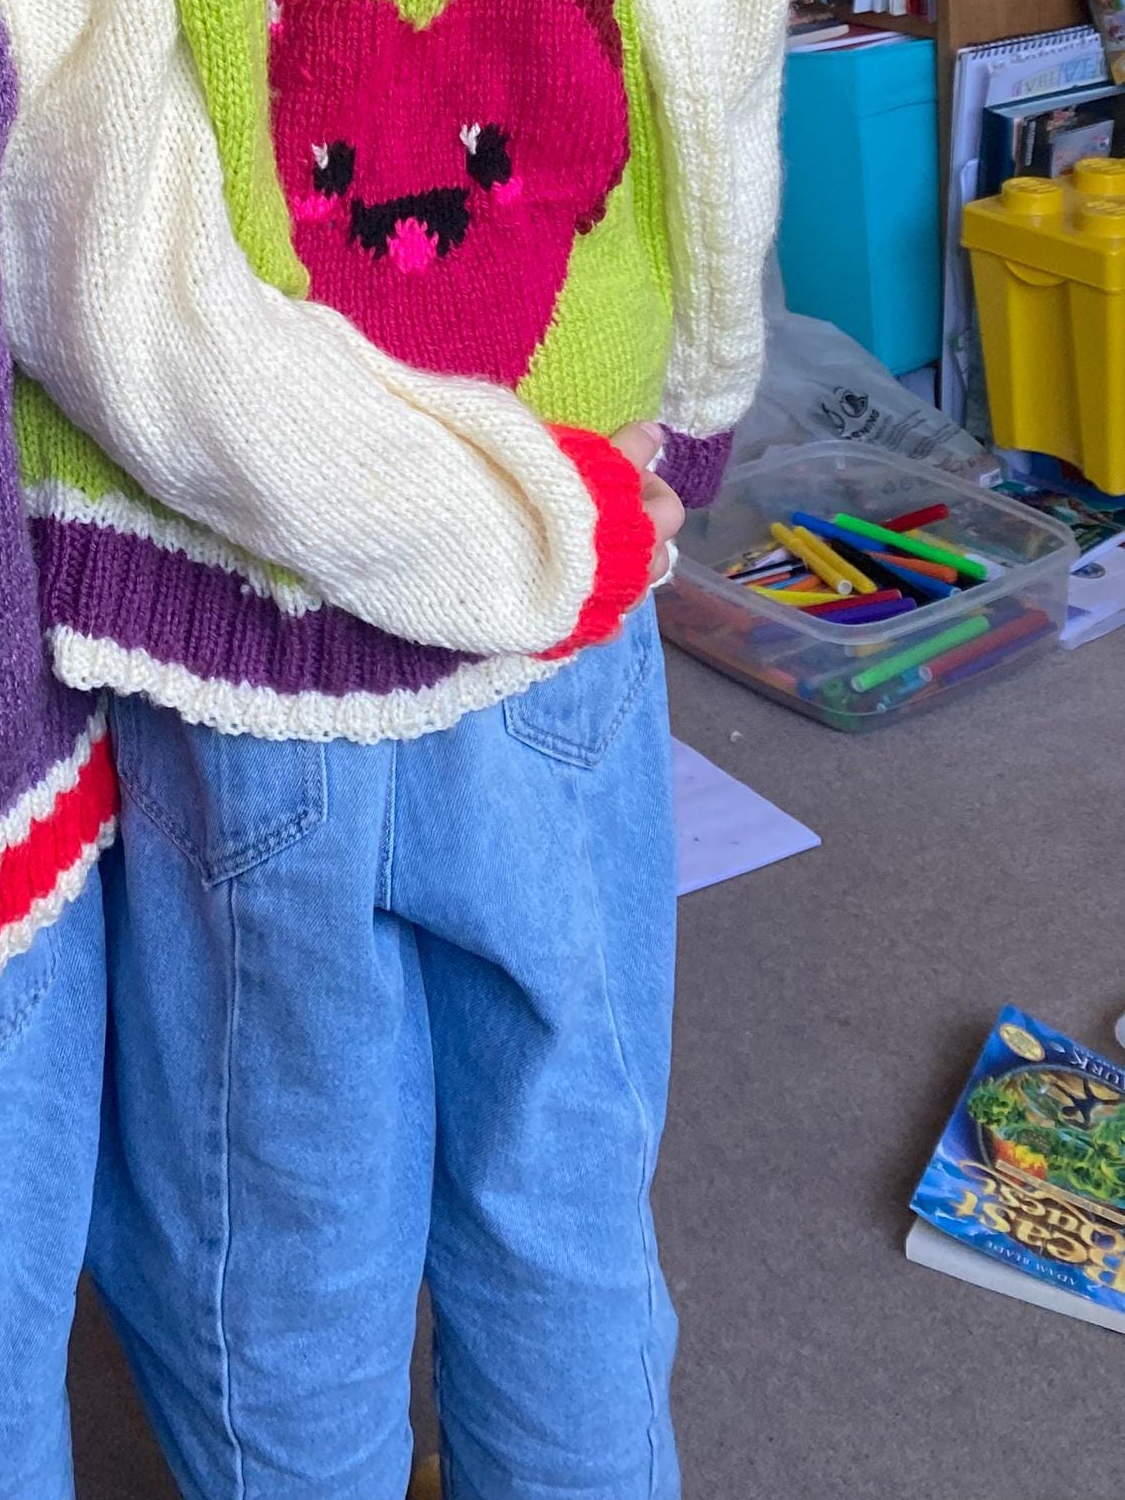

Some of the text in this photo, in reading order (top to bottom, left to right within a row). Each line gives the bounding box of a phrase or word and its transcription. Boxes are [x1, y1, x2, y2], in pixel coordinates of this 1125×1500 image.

[953, 1189, 1125, 1292] Beast
[975, 1168, 1122, 1258] Quest
[985, 1238, 1078, 1287] ADAM BLADE
